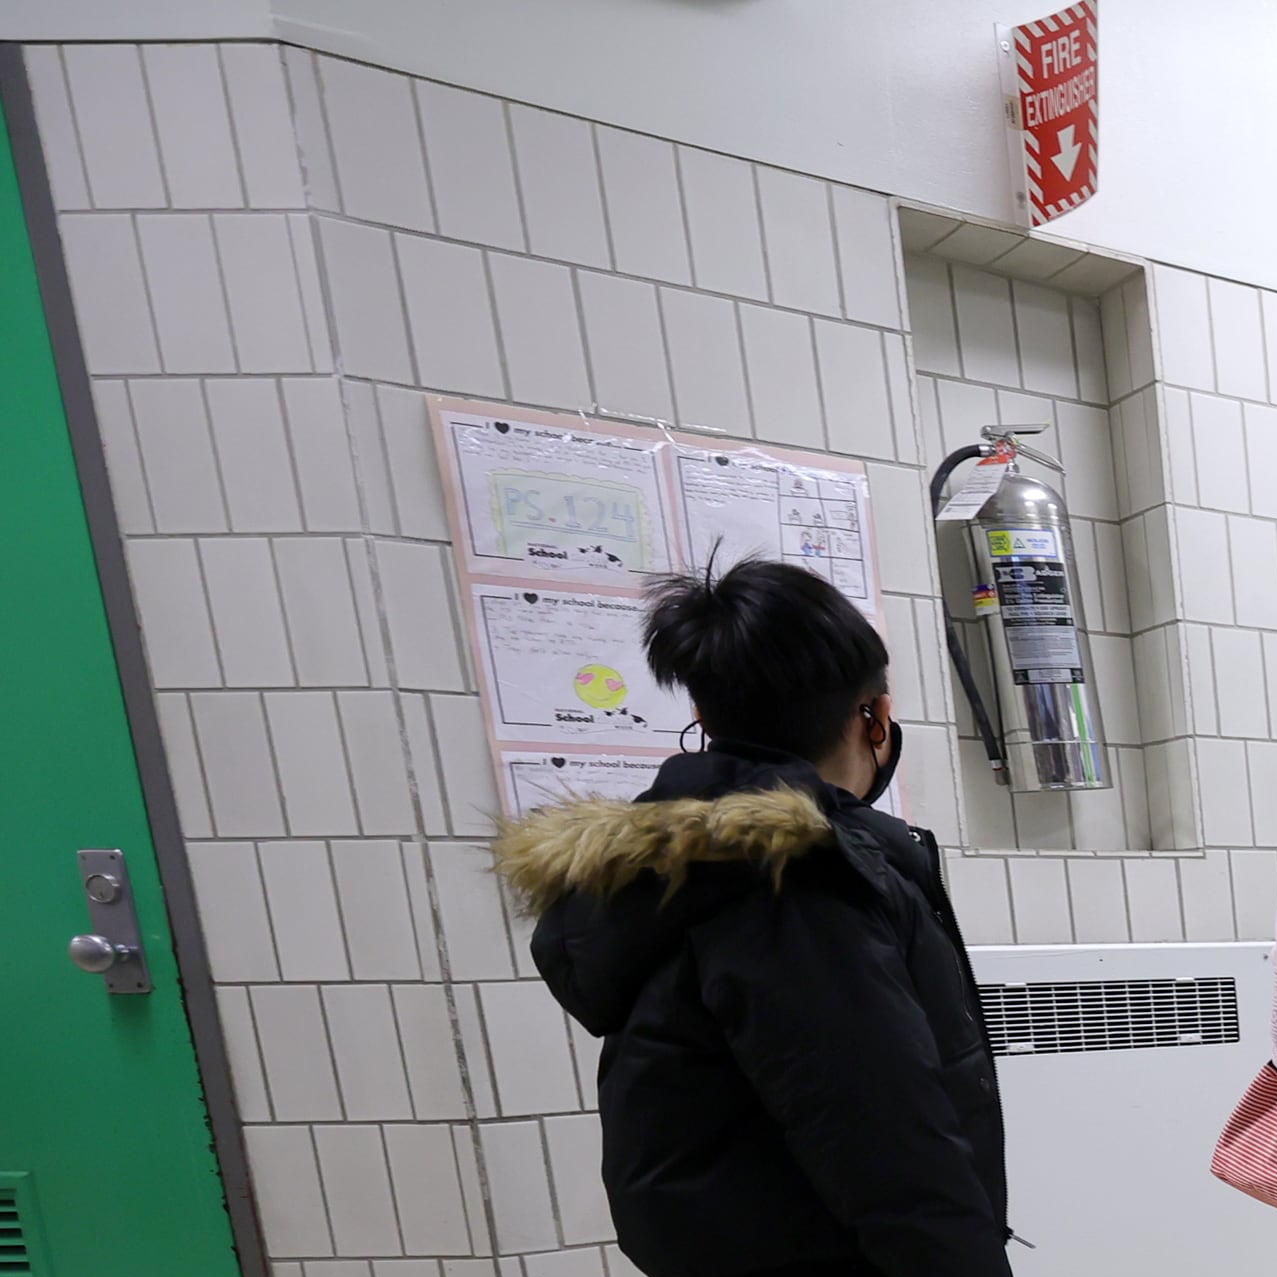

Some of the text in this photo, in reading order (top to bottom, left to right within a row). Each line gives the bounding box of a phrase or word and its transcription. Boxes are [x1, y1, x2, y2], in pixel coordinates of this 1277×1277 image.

[1041, 29, 1082, 79] FIRE
[1025, 66, 1096, 127] EXTINGUISHER
[534, 430, 571, 442] schoo
[527, 547, 568, 560] School
[542, 597, 558, 606] my
[562, 598, 595, 608] school
[555, 713, 595, 724] School
[569, 761, 586, 769] my
[589, 761, 621, 769] school
